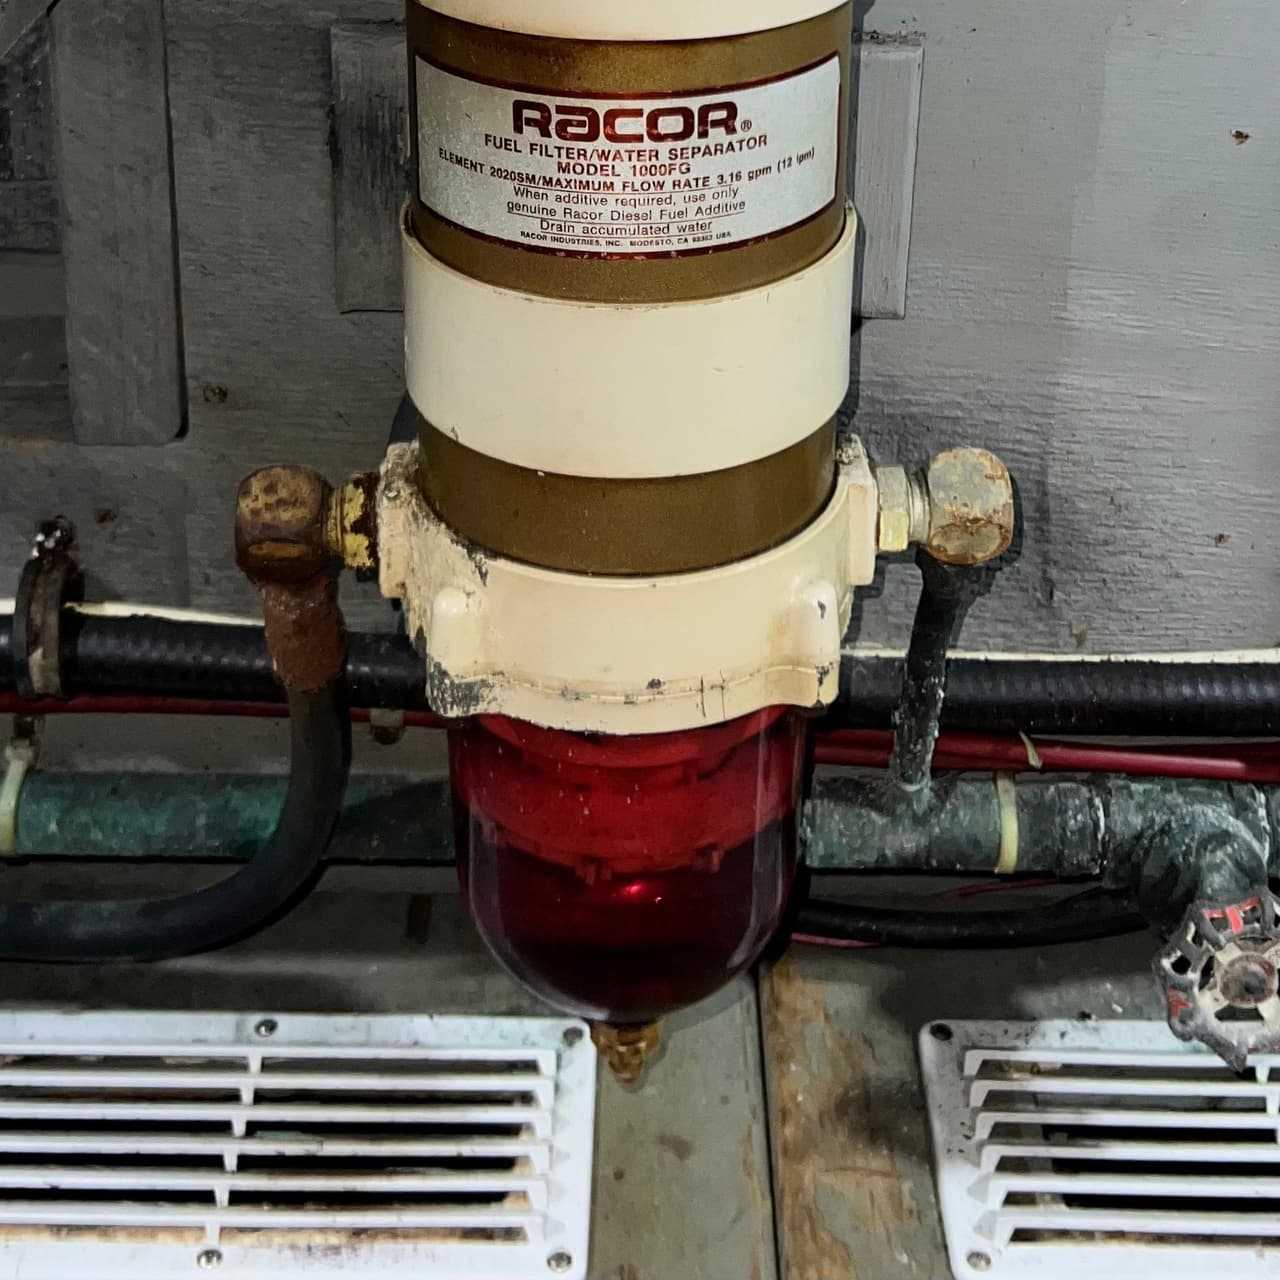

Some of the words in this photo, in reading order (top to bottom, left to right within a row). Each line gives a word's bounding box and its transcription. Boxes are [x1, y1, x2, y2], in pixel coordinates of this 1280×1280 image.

[484, 133, 522, 153] FUEL
[529, 142, 659, 162] FILTER/WATER
[668, 134, 768, 160] SEPARATOR
[439, 147, 485, 173] ELEMENT
[490, 166, 614, 192] 2020SM/MAXIMUM
[622, 180, 665, 192] FLOW
[672, 176, 710, 190] RATE
[717, 170, 742, 185] 3.16
[747, 165, 771, 181] gpm
[777, 156, 792, 173] (12
[557, 161, 621, 177] MODEL
[630, 161, 691, 177] 1000FG
[513, 185, 548, 201] When
[554, 191, 608, 206] additive
[615, 195, 676, 208] required,
[683, 192, 706, 203] use
[712, 187, 739, 200] only
[507, 201, 557, 217] genuine
[563, 207, 603, 221] Racor
[610, 210, 652, 221] Diesel
[659, 207, 688, 220] Fuel
[694, 200, 745, 217] Additive
[520, 230, 547, 241] RACOR
[540, 219, 575, 234] Drain
[582, 223, 670, 236] accumulated
[677, 221, 712, 233] water
